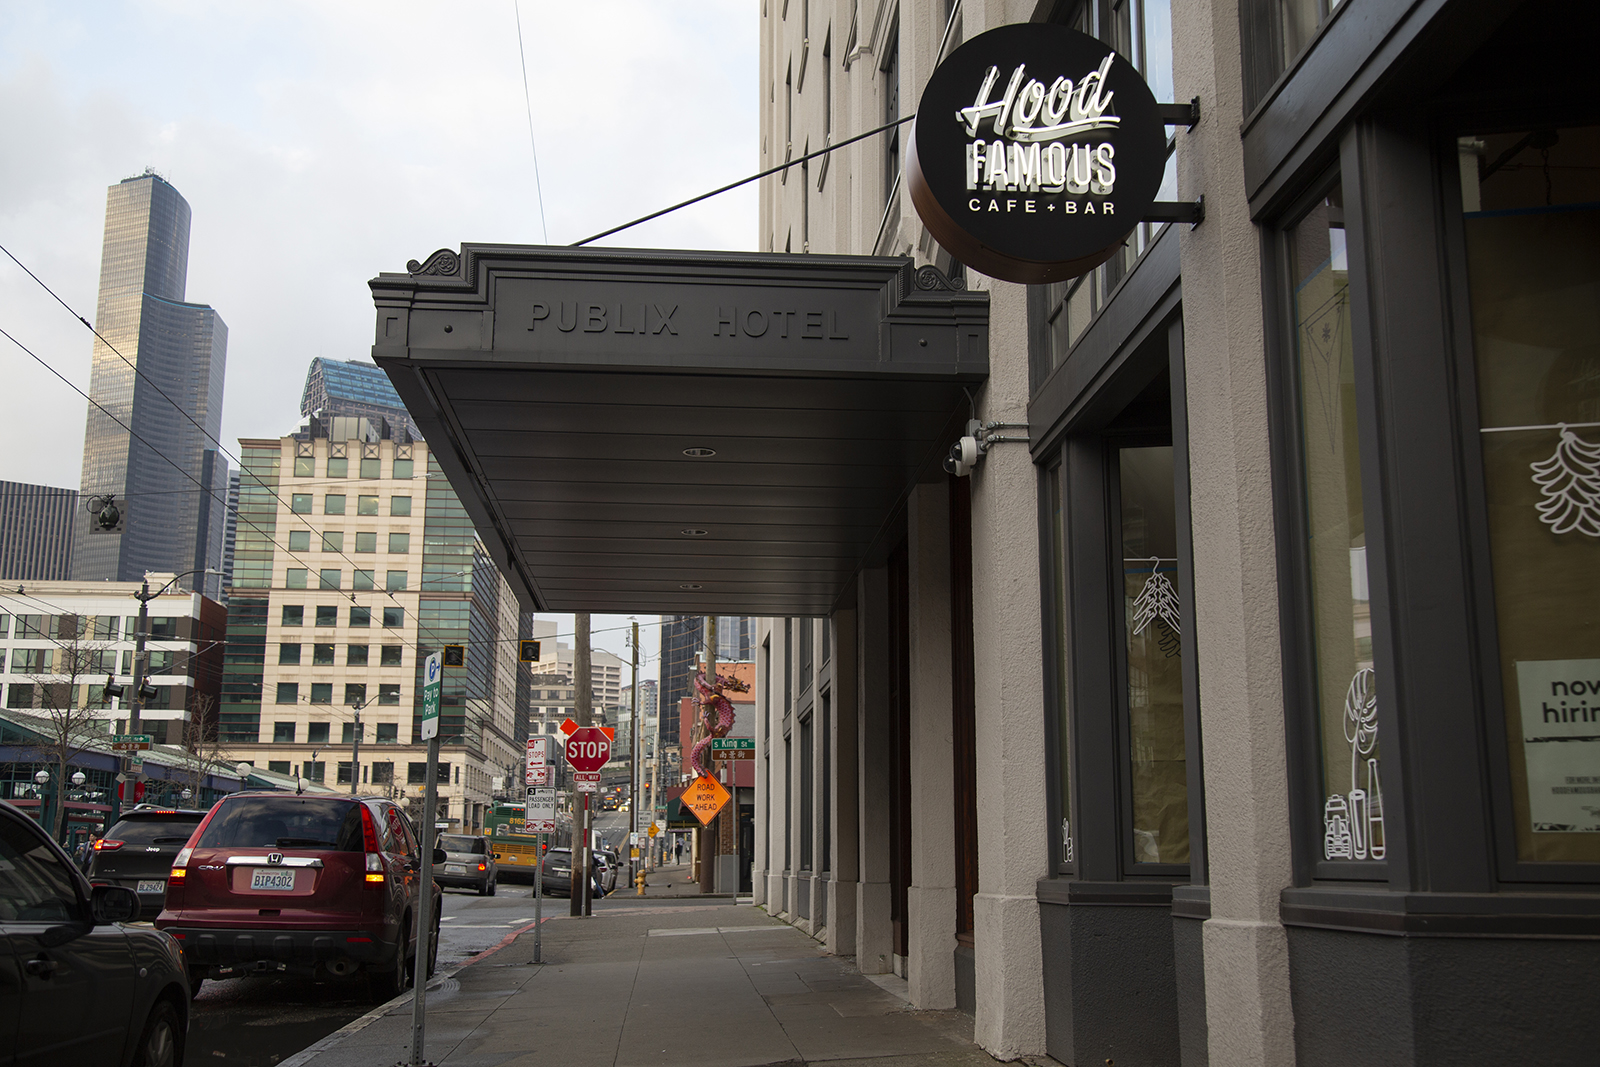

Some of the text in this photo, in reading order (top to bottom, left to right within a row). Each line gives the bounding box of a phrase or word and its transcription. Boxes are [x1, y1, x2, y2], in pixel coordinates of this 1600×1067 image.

[957, 51, 1119, 134] Hood
[966, 139, 1116, 194] FAMOUS
[968, 198, 1037, 213] CAFE
[1065, 200, 1115, 215] BAR
[527, 301, 849, 341] PUBLIX HOTEL
[423, 687, 439, 702] Pay to
[425, 702, 436, 715] Park
[568, 741, 608, 759] STOP
[722, 739, 738, 749] King
[528, 750, 545, 759] STOPS
[697, 783, 716, 791] ROAD
[695, 803, 718, 811] AHEAD
[509, 817, 526, 825] 8162
[254, 875, 293, 887] BIP4302
